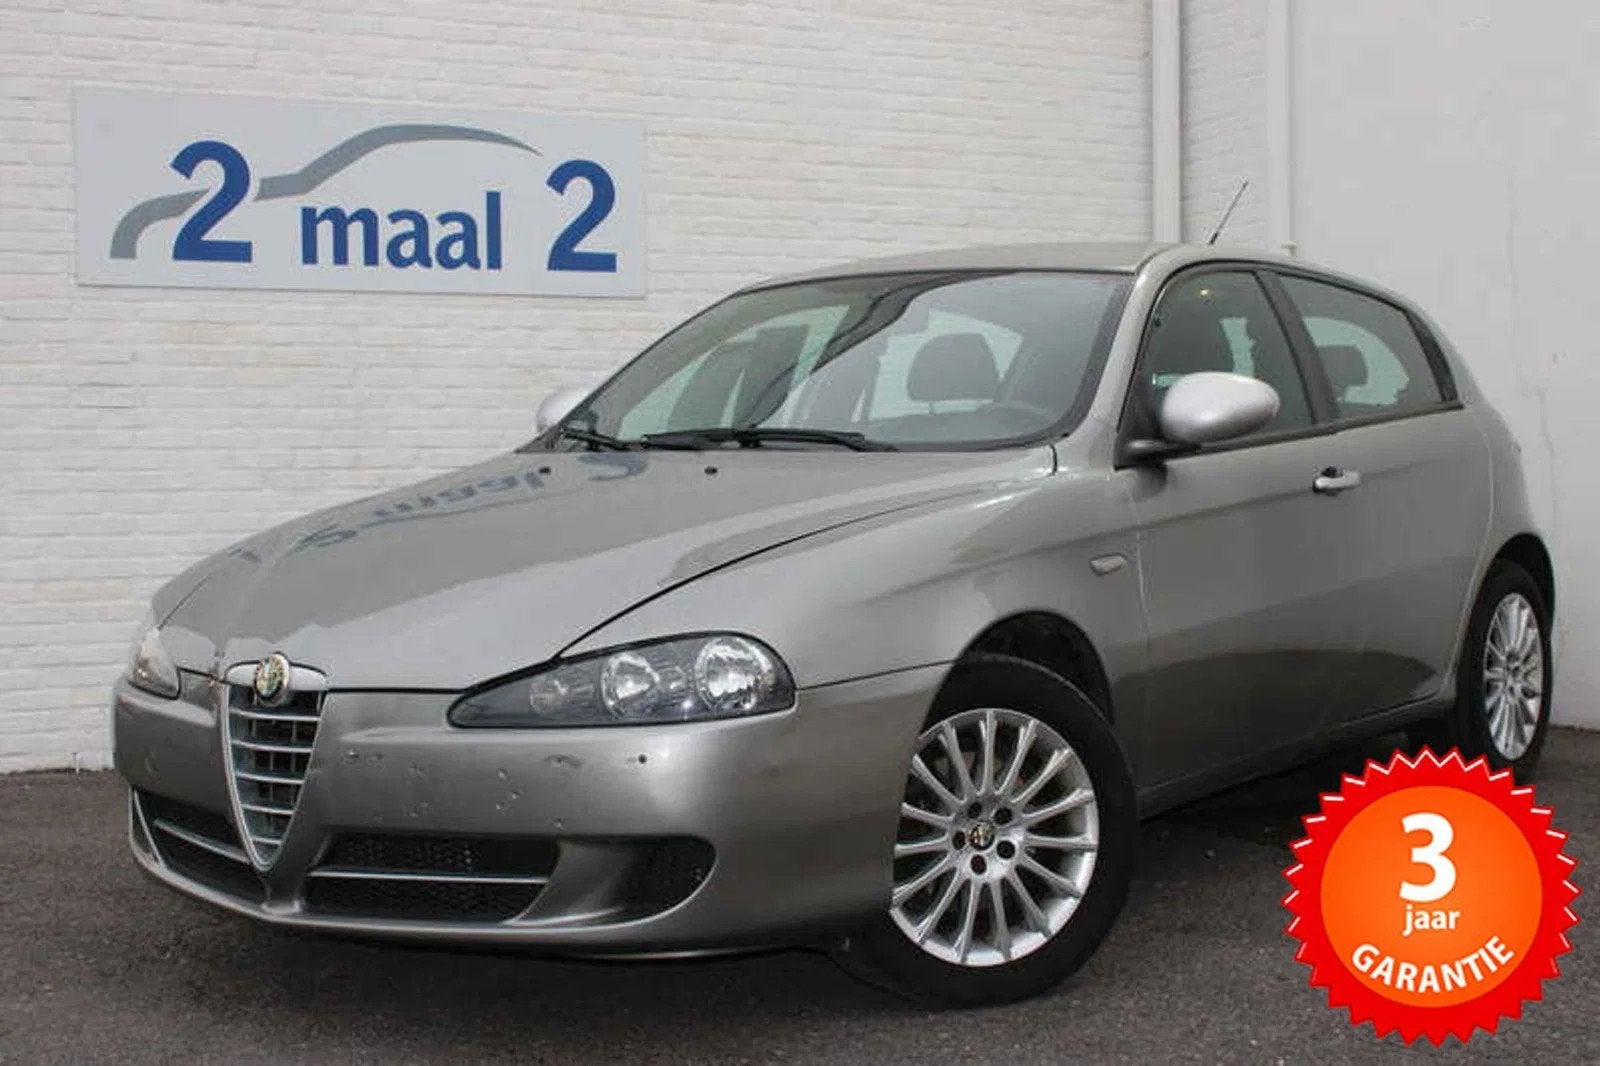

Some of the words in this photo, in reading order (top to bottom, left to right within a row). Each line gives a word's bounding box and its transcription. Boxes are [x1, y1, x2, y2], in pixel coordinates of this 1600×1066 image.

[170, 140, 252, 263] 2
[299, 190, 502, 271] maal
[547, 159, 618, 273] 2
